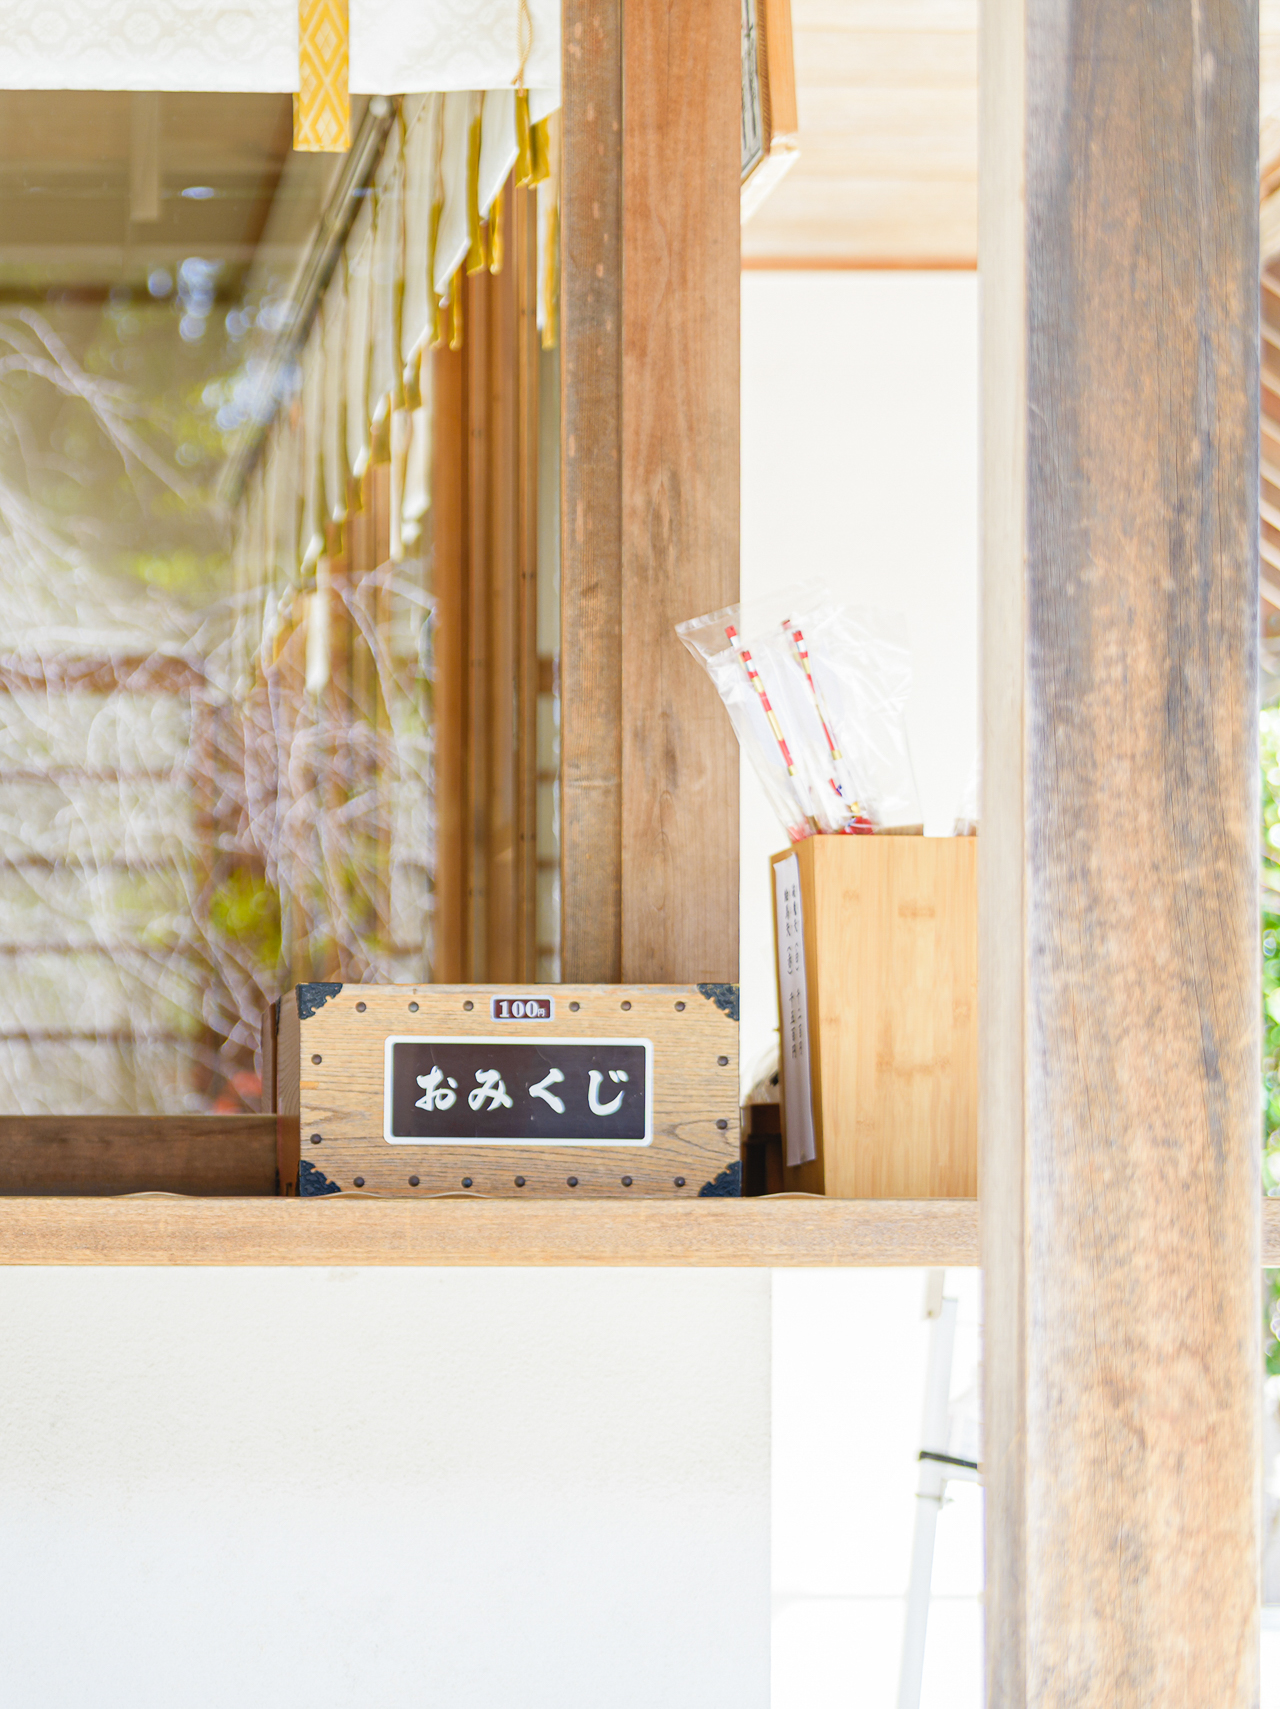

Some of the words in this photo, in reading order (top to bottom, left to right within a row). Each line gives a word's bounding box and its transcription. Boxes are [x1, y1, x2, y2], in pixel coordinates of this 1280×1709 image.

[499, 1001, 546, 1018] 100円
[415, 1065, 629, 1116] おみくじ
